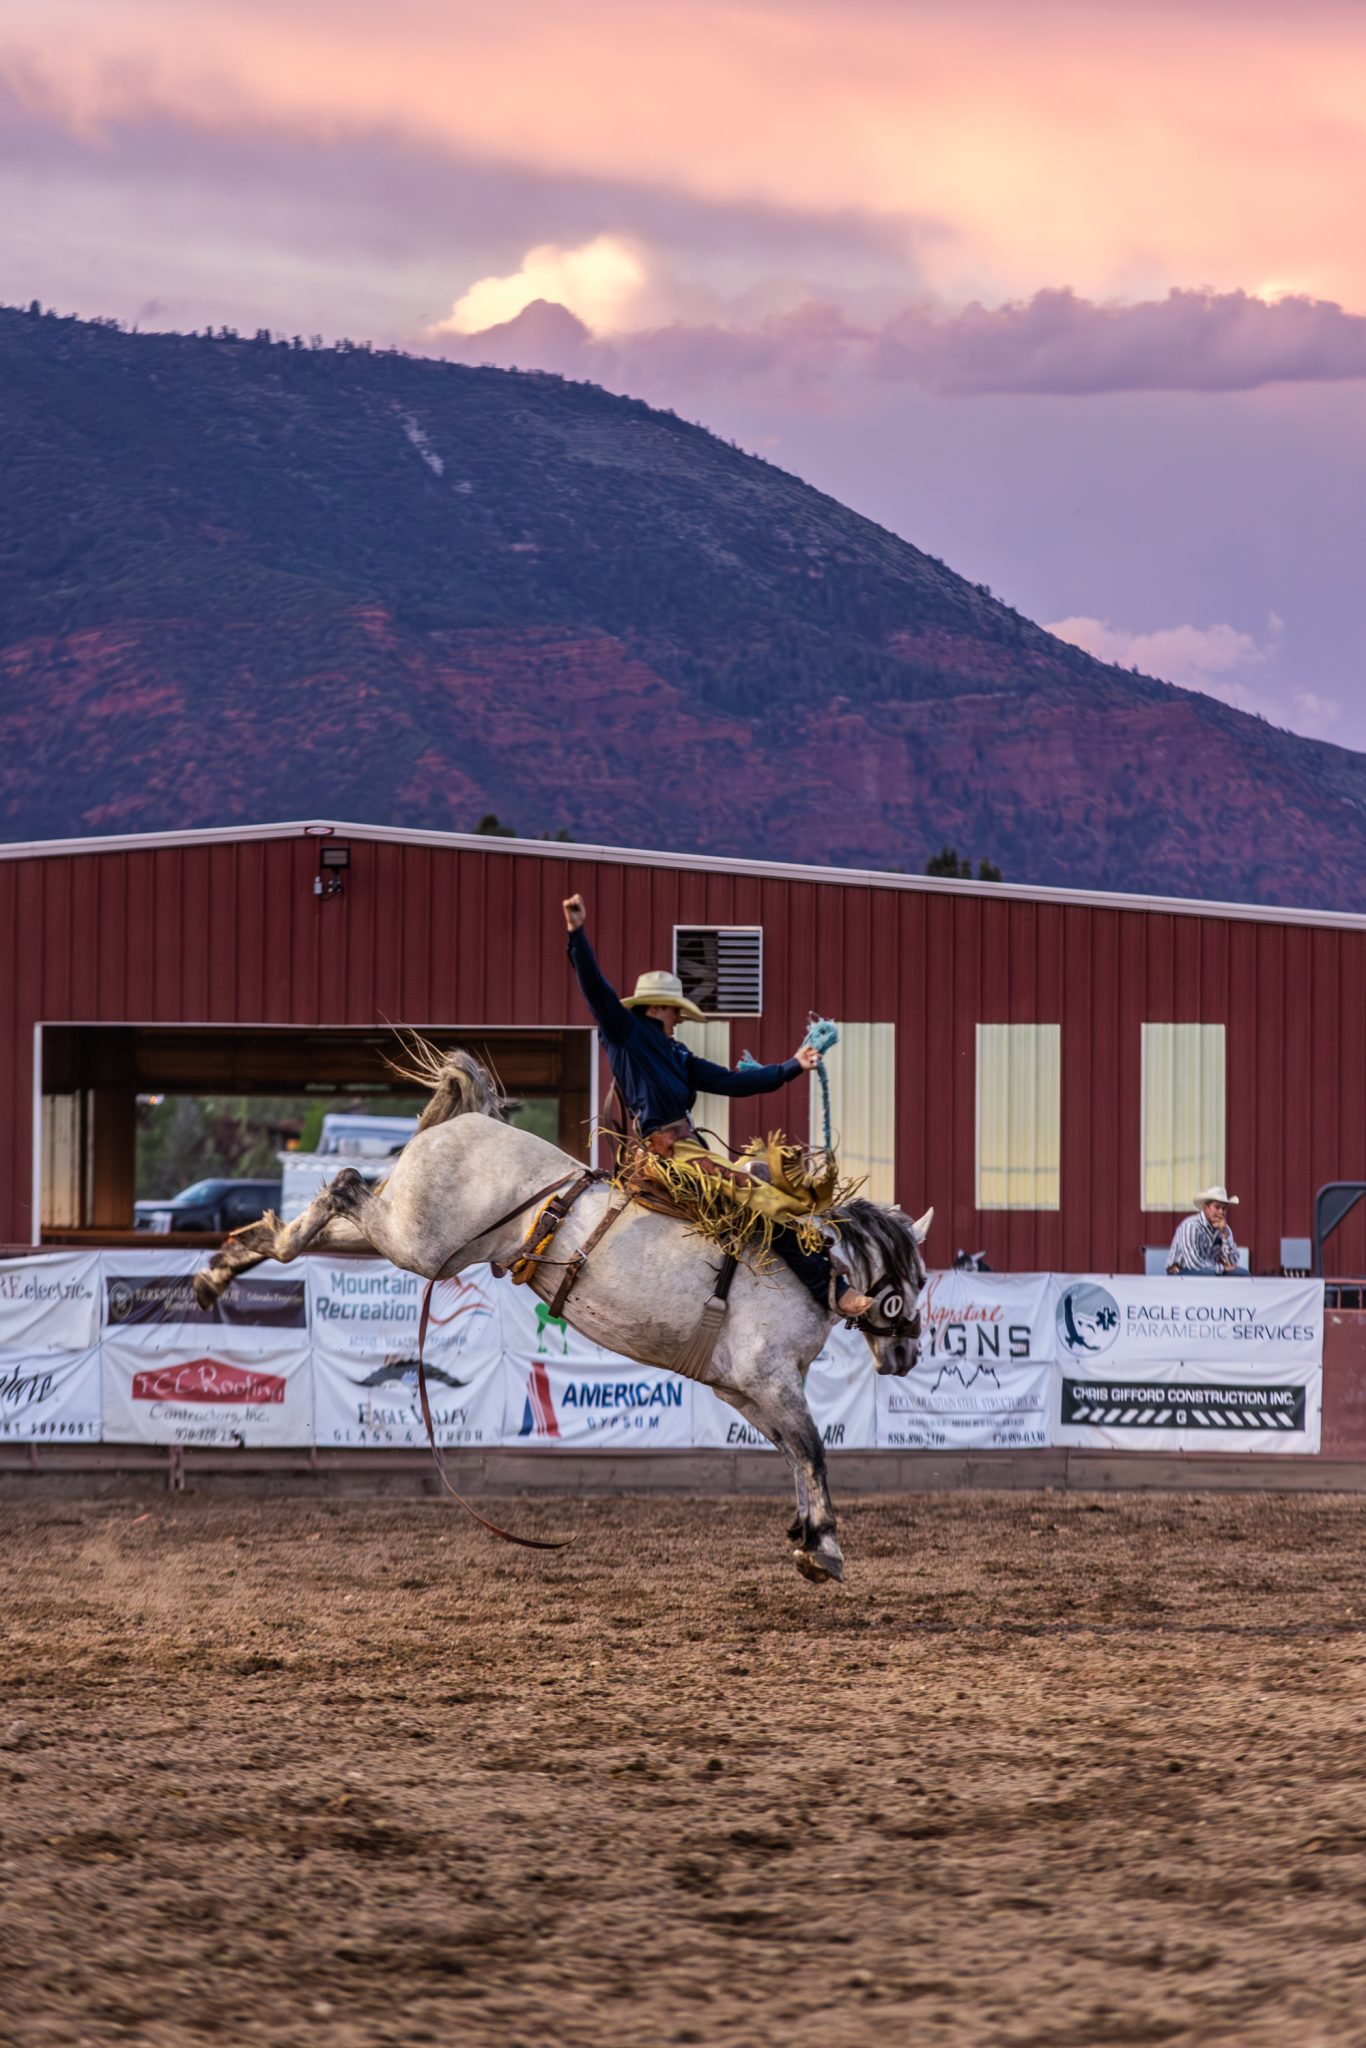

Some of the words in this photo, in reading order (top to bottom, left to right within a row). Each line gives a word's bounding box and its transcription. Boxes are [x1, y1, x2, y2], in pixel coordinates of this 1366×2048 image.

[331, 1272, 417, 1295] Mountain
[316, 1297, 417, 1321] Recreation
[920, 1274, 1004, 1346] Signature
[1127, 1305, 1180, 1321] EAGLE
[1185, 1307, 1257, 1322] COUNTY
[917, 1324, 1031, 1357] IGNS
[1127, 1323, 1228, 1339] PARAMEDIC
[1232, 1325, 1314, 1341] SERVICES
[136, 1368, 195, 1396] TCC
[198, 1365, 283, 1402] Roofing
[561, 1381, 683, 1408] AMERICAN
[1072, 1386, 1108, 1401] CHRIS
[1111, 1387, 1165, 1402] GIFFORD
[1168, 1388, 1267, 1405] CONSTRUCTION
[1270, 1391, 1295, 1406] INC.
[246, 1406, 270, 1423] Inc.
[358, 1403, 410, 1424] EAGLE
[587, 1416, 659, 1429] GYPSUM
[1176, 1409, 1187, 1425] G
[31, 1421, 95, 1436] SUPPORT
[333, 1429, 393, 1442] GLASS
[405, 1430, 413, 1442] &
[726, 1422, 771, 1444] EAGL
